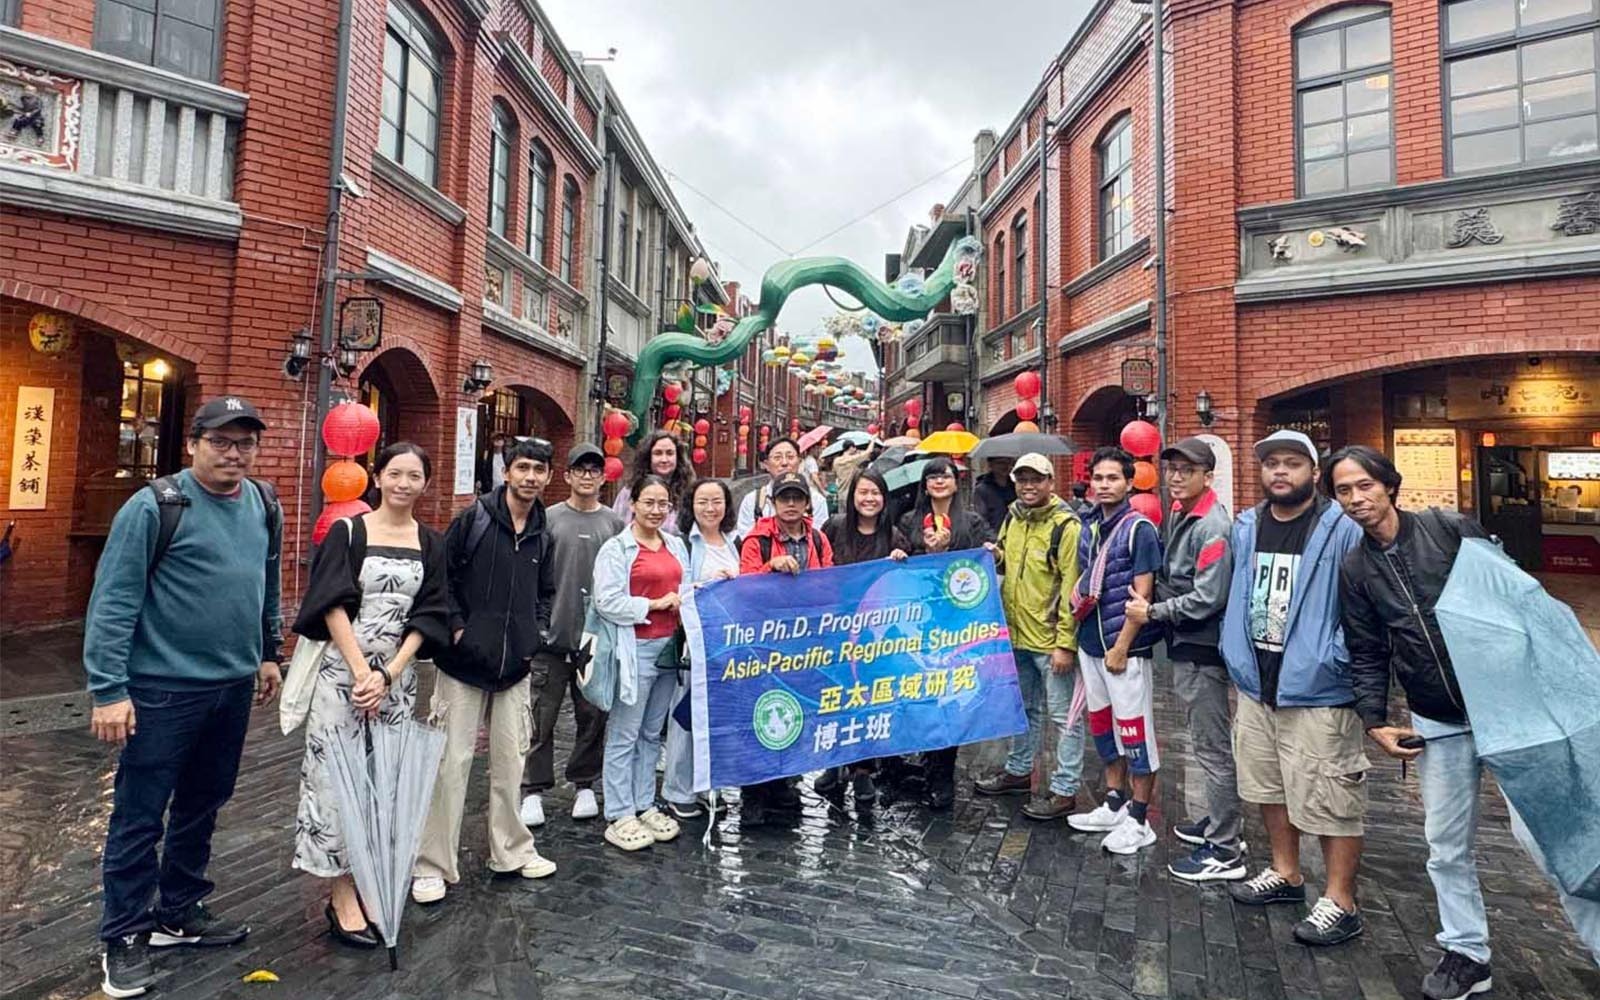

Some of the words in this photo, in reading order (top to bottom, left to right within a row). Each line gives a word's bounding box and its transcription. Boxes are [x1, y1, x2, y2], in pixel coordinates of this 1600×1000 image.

[722, 624, 755, 647] The
[760, 617, 812, 643] Ph.D.
[818, 605, 899, 638] Program
[905, 602, 922, 621] in
[721, 648, 833, 681] Asia-Pacific
[839, 635, 923, 663] Regional
[928, 620, 1000, 651] Studies
[817, 664, 977, 715] 亞太區域研究
[813, 713, 891, 753] 博士班
